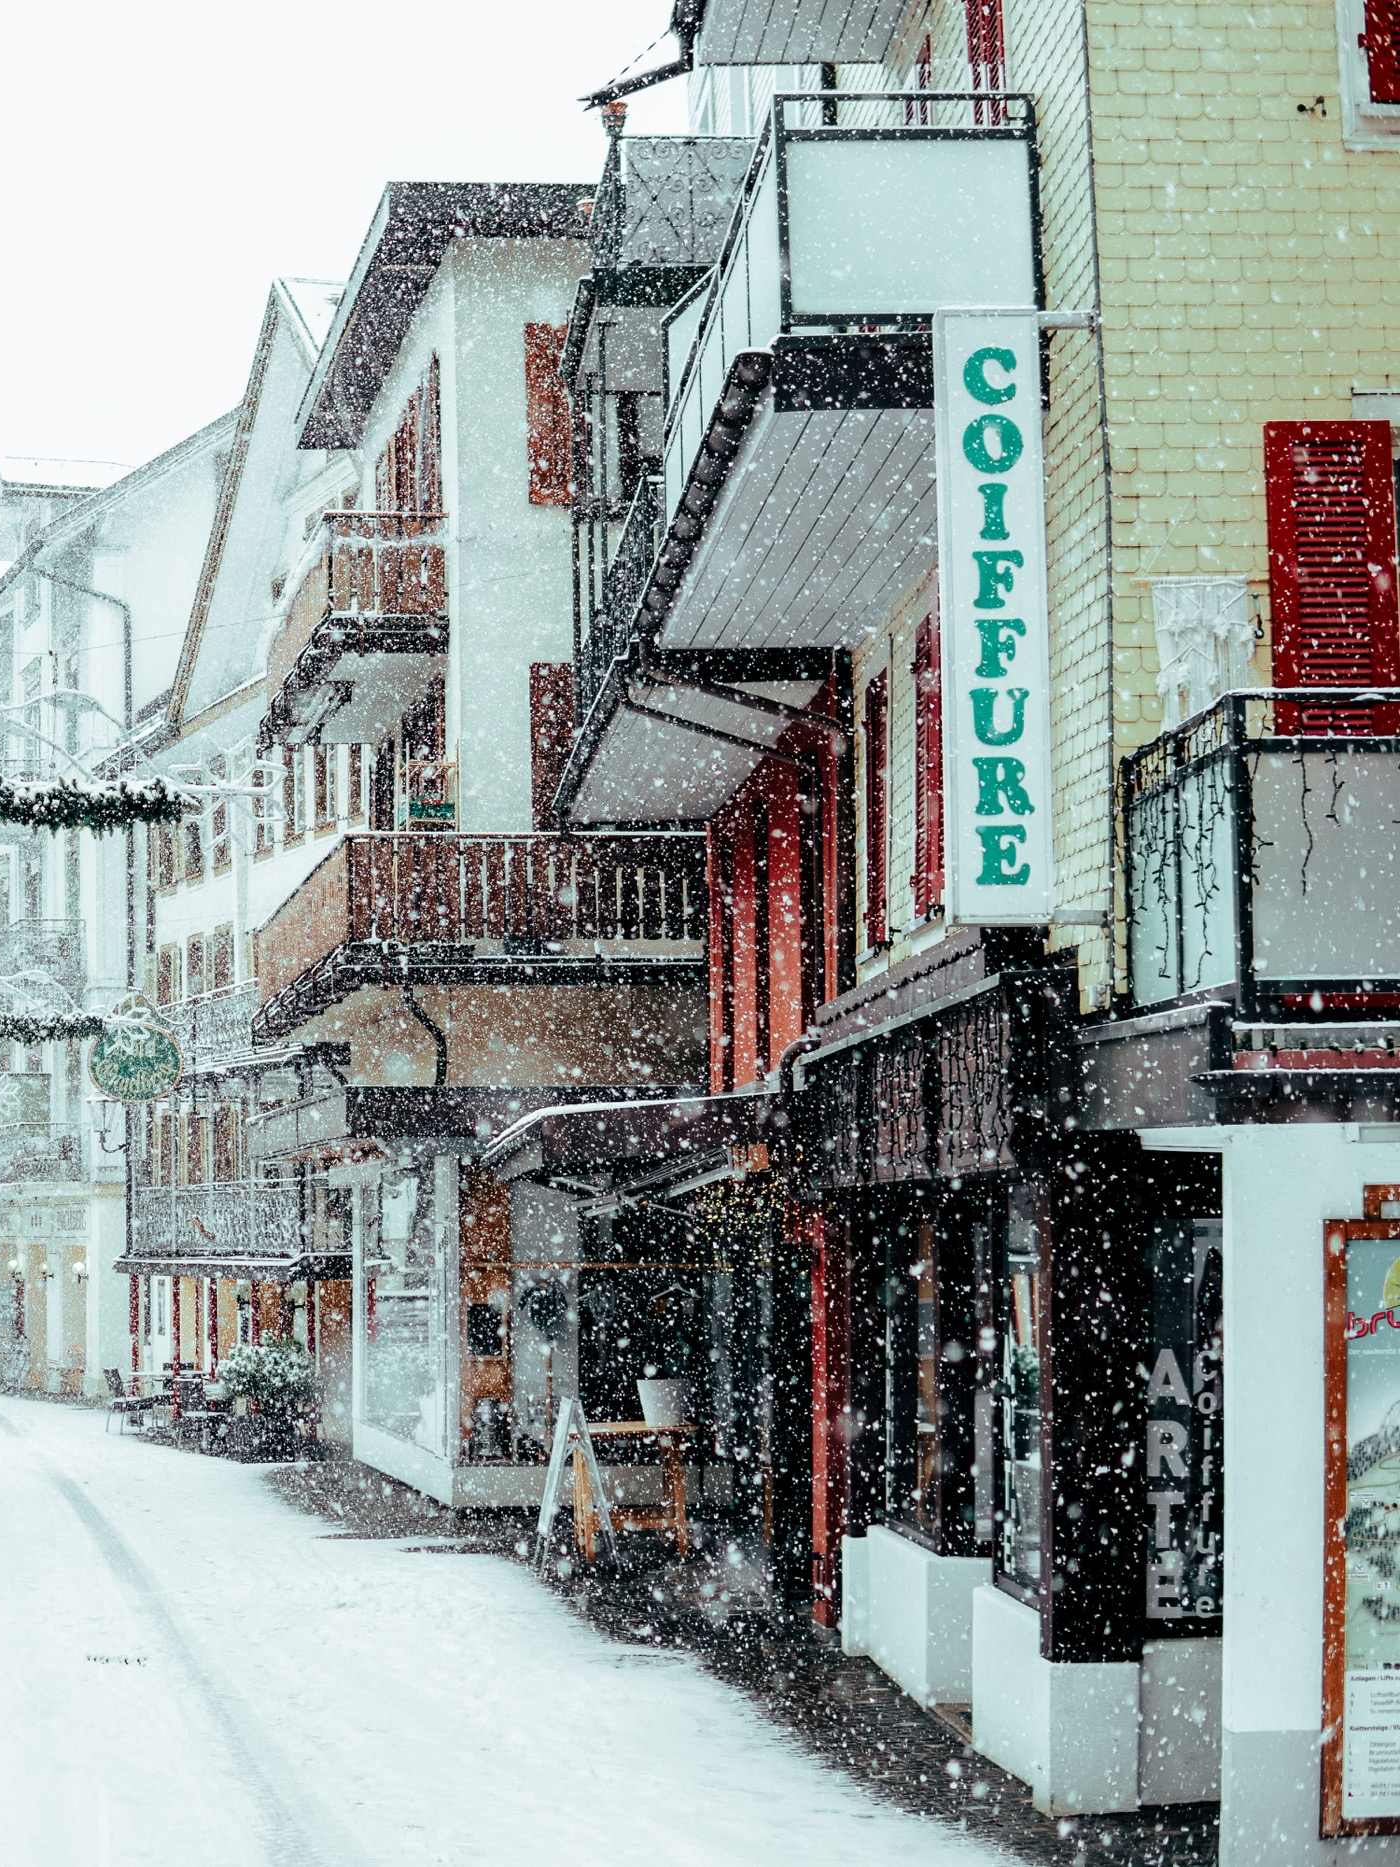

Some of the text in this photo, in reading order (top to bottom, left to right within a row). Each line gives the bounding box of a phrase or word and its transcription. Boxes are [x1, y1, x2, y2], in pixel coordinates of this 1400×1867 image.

[962, 346, 1035, 886] COIFFURE
[1146, 1348, 1192, 1619] ARTE
[1197, 1350, 1217, 1619] Coiffure
